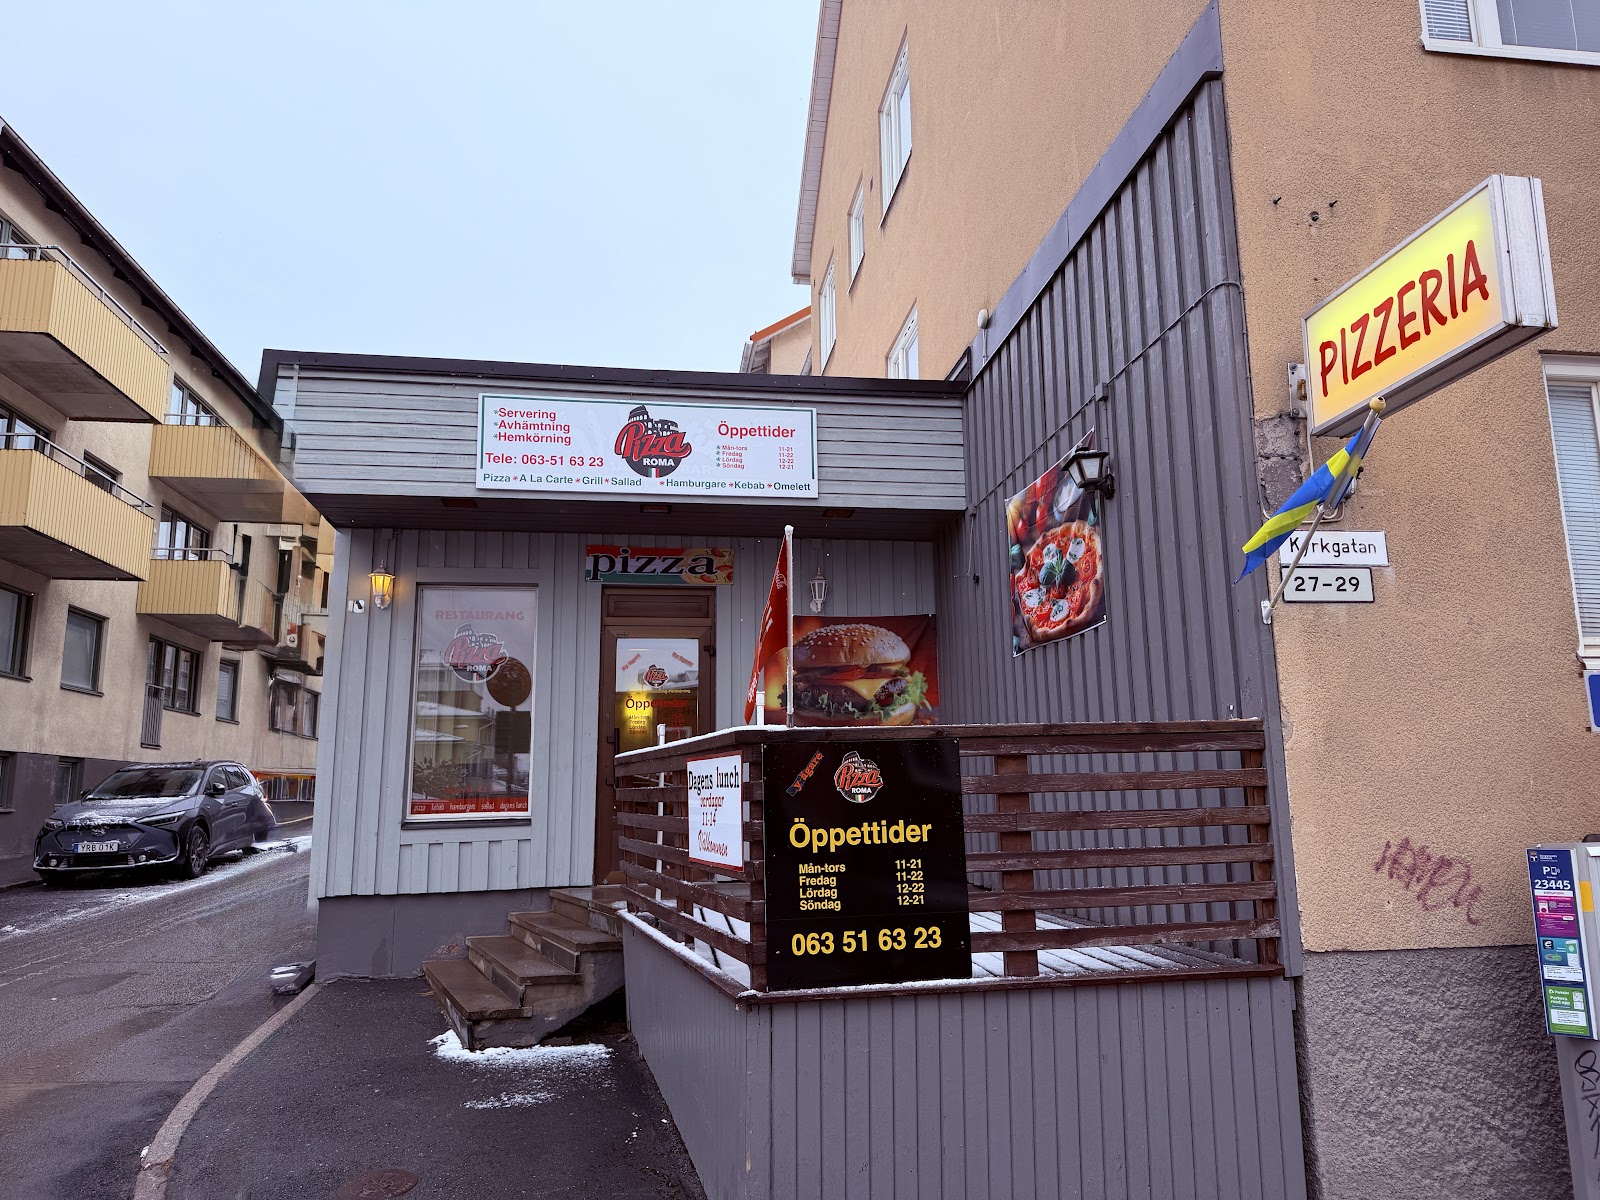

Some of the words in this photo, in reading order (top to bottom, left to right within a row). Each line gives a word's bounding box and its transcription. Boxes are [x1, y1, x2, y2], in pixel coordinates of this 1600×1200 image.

[1319, 239, 1489, 397] PIZZERIA
[498, 407, 556, 421] Servering
[498, 420, 570, 433] Avhämtning
[717, 420, 796, 439] Öppettider
[498, 431, 571, 446] Hemkörning
[614, 421, 692, 461] Pizza
[485, 452, 518, 464] Tele:
[521, 454, 564, 466] 063-51
[569, 456, 585, 467] 63
[588, 456, 604, 468] 23
[643, 458, 675, 467] ROMA
[483, 473, 511, 483] Pizza
[519, 473, 527, 482] A
[530, 474, 543, 483] La
[545, 475, 573, 484] Carte
[582, 476, 603, 485] Grill
[611, 477, 642, 486] Sallad
[666, 478, 727, 490] Hamburgare
[734, 481, 765, 490] Kebab
[773, 481, 811, 491] Omelett
[586, 546, 719, 582] pizza
[1293, 575, 1360, 592] 27-29
[435, 610, 525, 621] RESTAURANG
[443, 635, 509, 668] Pizza
[688, 770, 713, 796] Dagens
[716, 765, 740, 788] lunch
[834, 763, 884, 791] Pizza
[481, 801, 495, 810] sallad
[789, 817, 932, 853] Öppettider
[799, 863, 846, 874] Mån-tors
[895, 858, 922, 869] 11-21
[896, 870, 924, 881] 11-22
[1542, 866, 1550, 875] P
[799, 875, 837, 887] Fredag
[896, 882, 925, 893] 12-22
[1534, 879, 1571, 890] 23445
[800, 887, 838, 899] Lördag
[800, 899, 841, 911] Söndag
[896, 894, 925, 906] 12-21
[791, 931, 835, 956] 063
[842, 929, 868, 953] 51
[878, 927, 907, 951] 63
[913, 926, 942, 949] 23
